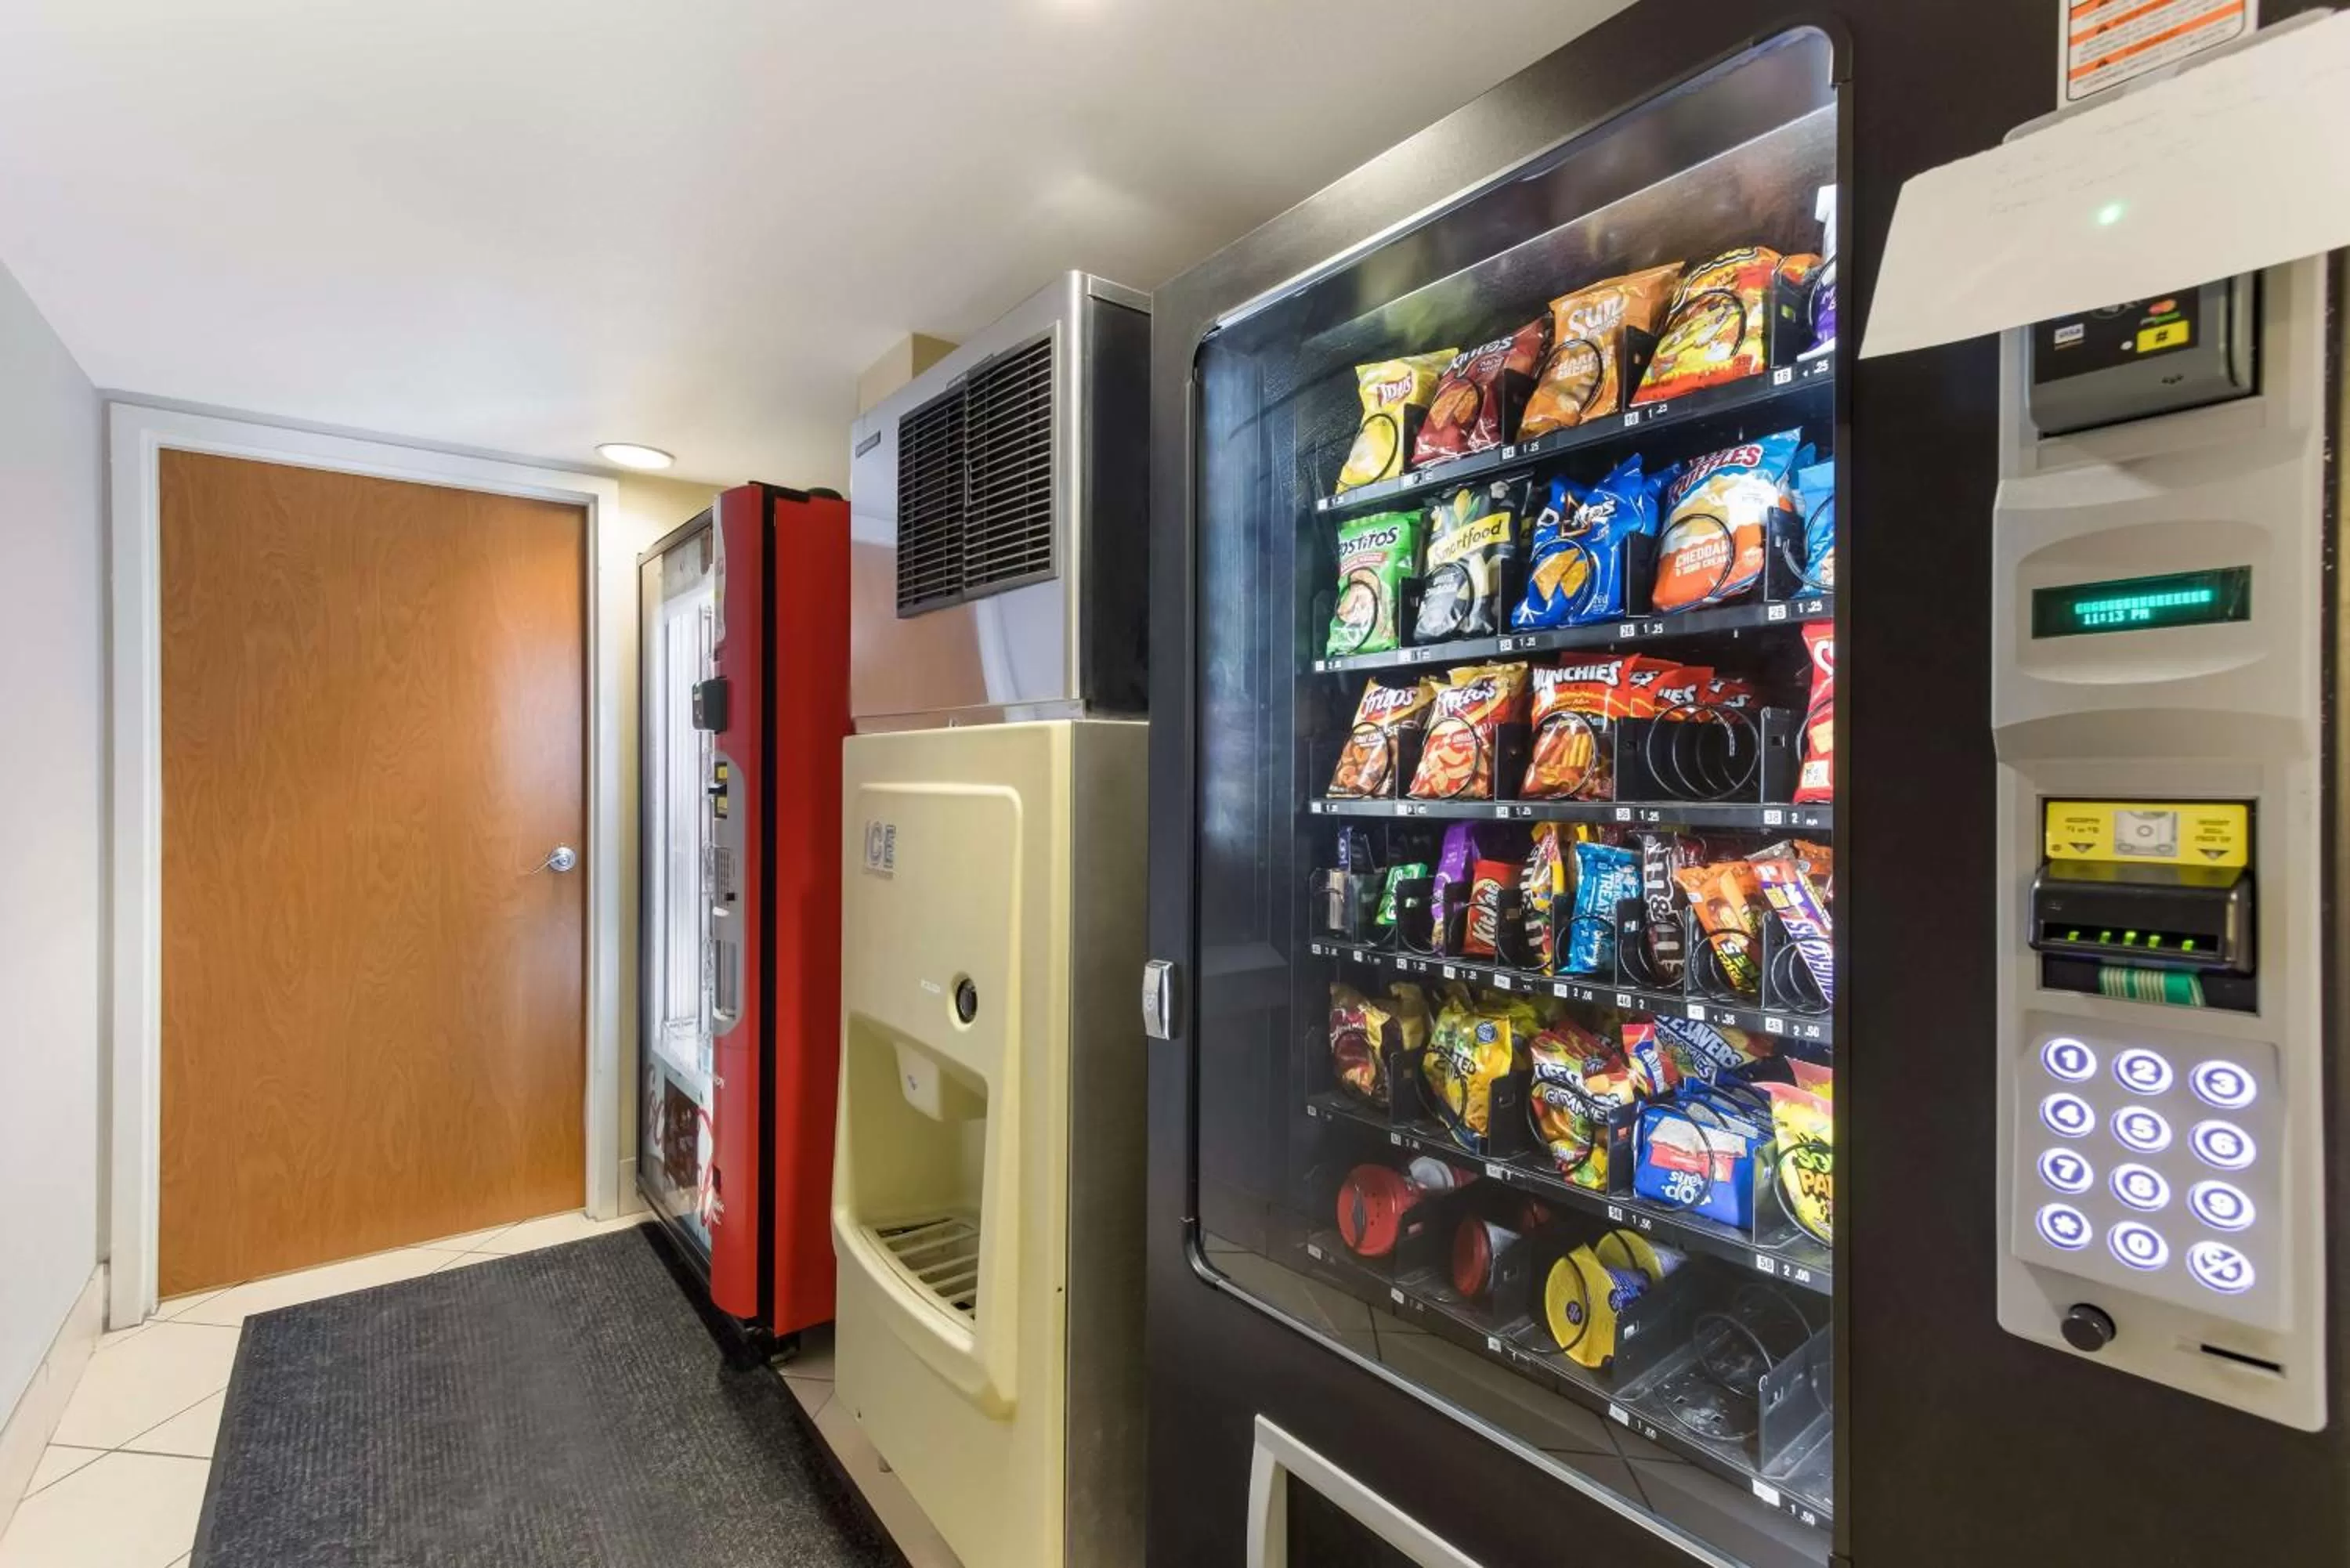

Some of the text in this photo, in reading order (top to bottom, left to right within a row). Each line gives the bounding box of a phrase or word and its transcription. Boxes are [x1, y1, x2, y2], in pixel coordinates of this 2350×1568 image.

[1434, 518, 1502, 563] Smartfood
[2084, 608, 2149, 625] 11:13 PM
[1792, 813, 1799, 823] 2
[1793, 1026, 1799, 1036] 2
[2061, 1049, 2238, 1097] 1 2 3
[2056, 1104, 2081, 1127] 4
[2129, 1115, 2156, 1140] 5
[2056, 1158, 2080, 1181] 7
[2126, 1230, 2155, 1259] 0
